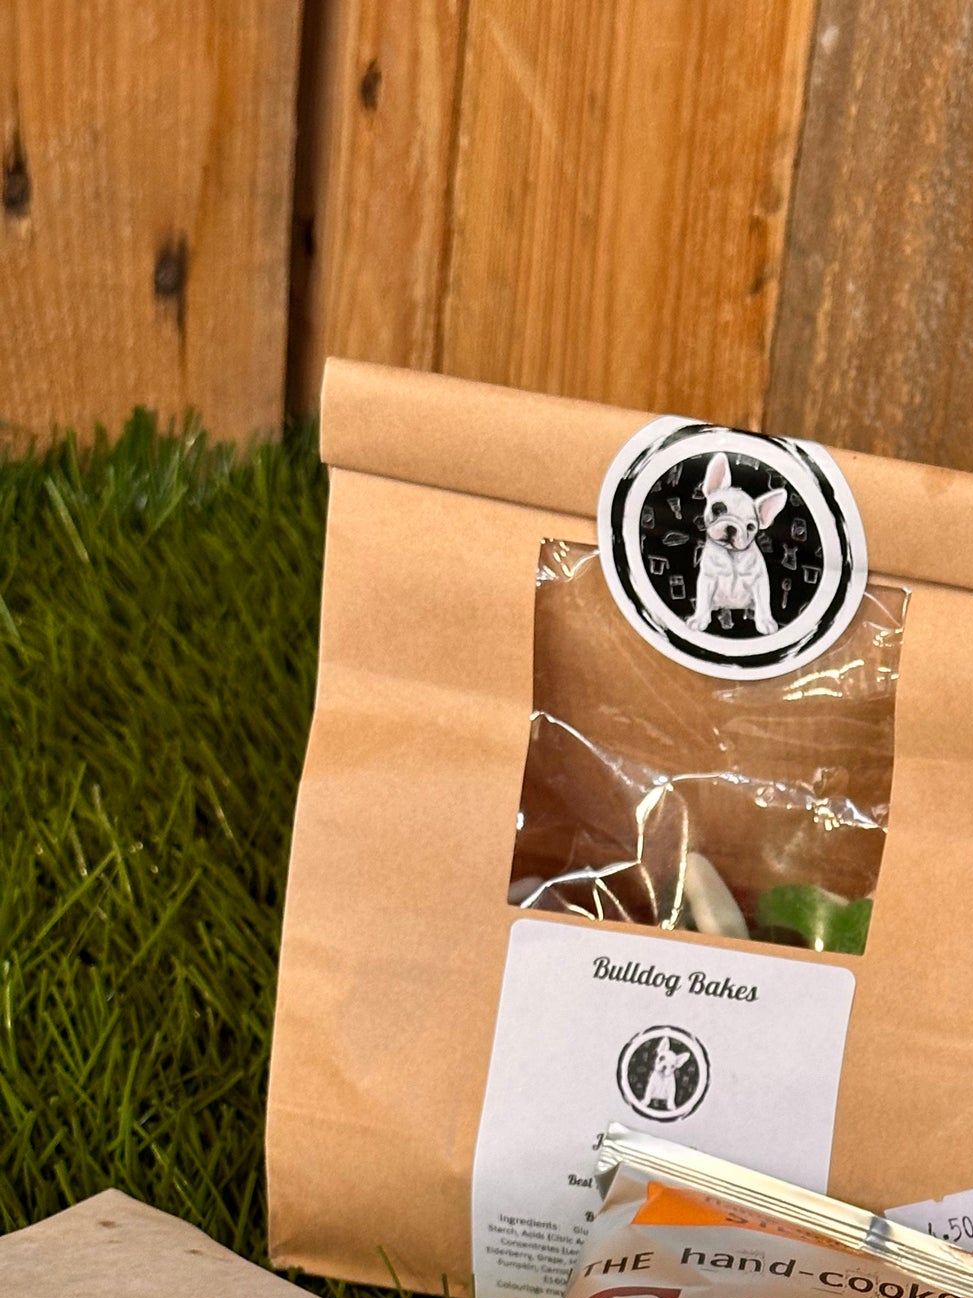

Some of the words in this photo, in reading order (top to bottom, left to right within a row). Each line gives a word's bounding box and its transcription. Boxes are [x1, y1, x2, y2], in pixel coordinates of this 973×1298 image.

[593, 956, 681, 997] Bulldog
[688, 971, 759, 1002] Bakes
[584, 1251, 655, 1279] THE
